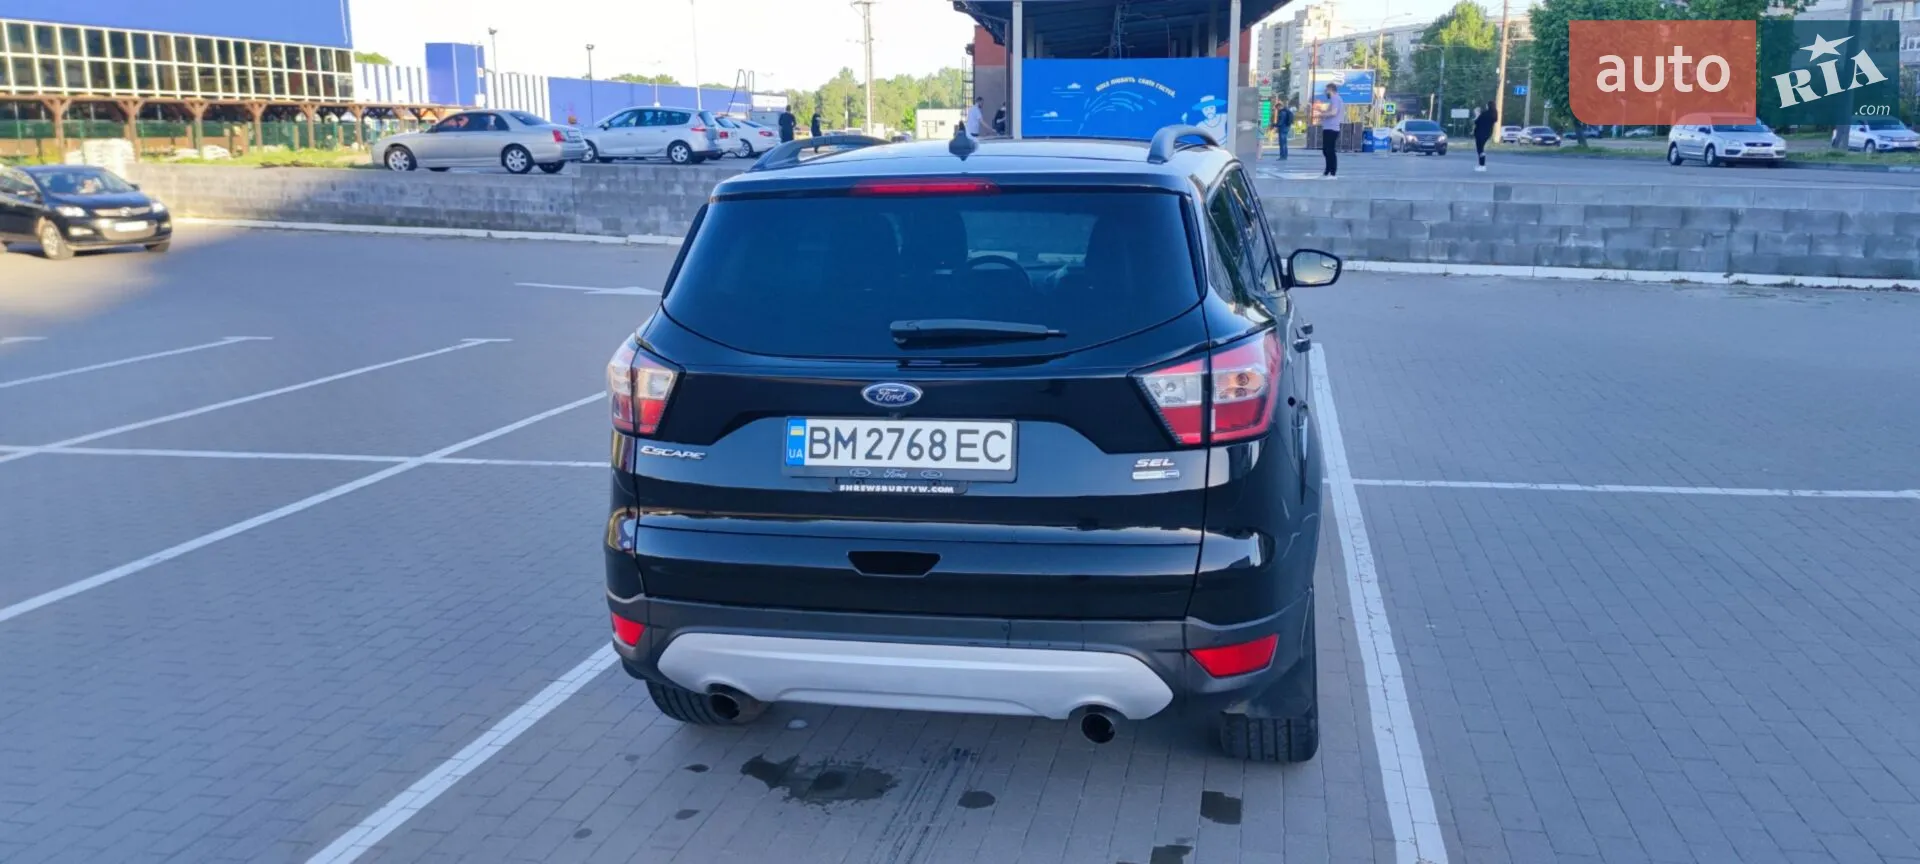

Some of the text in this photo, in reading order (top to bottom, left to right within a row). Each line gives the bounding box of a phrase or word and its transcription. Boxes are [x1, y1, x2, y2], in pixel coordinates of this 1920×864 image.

[876, 387, 907, 402] Ford
[808, 426, 1007, 463] BM 2768 EC
[640, 445, 707, 460] ESCAPE
[788, 449, 803, 459] UA
[1134, 458, 1175, 468] SEL
